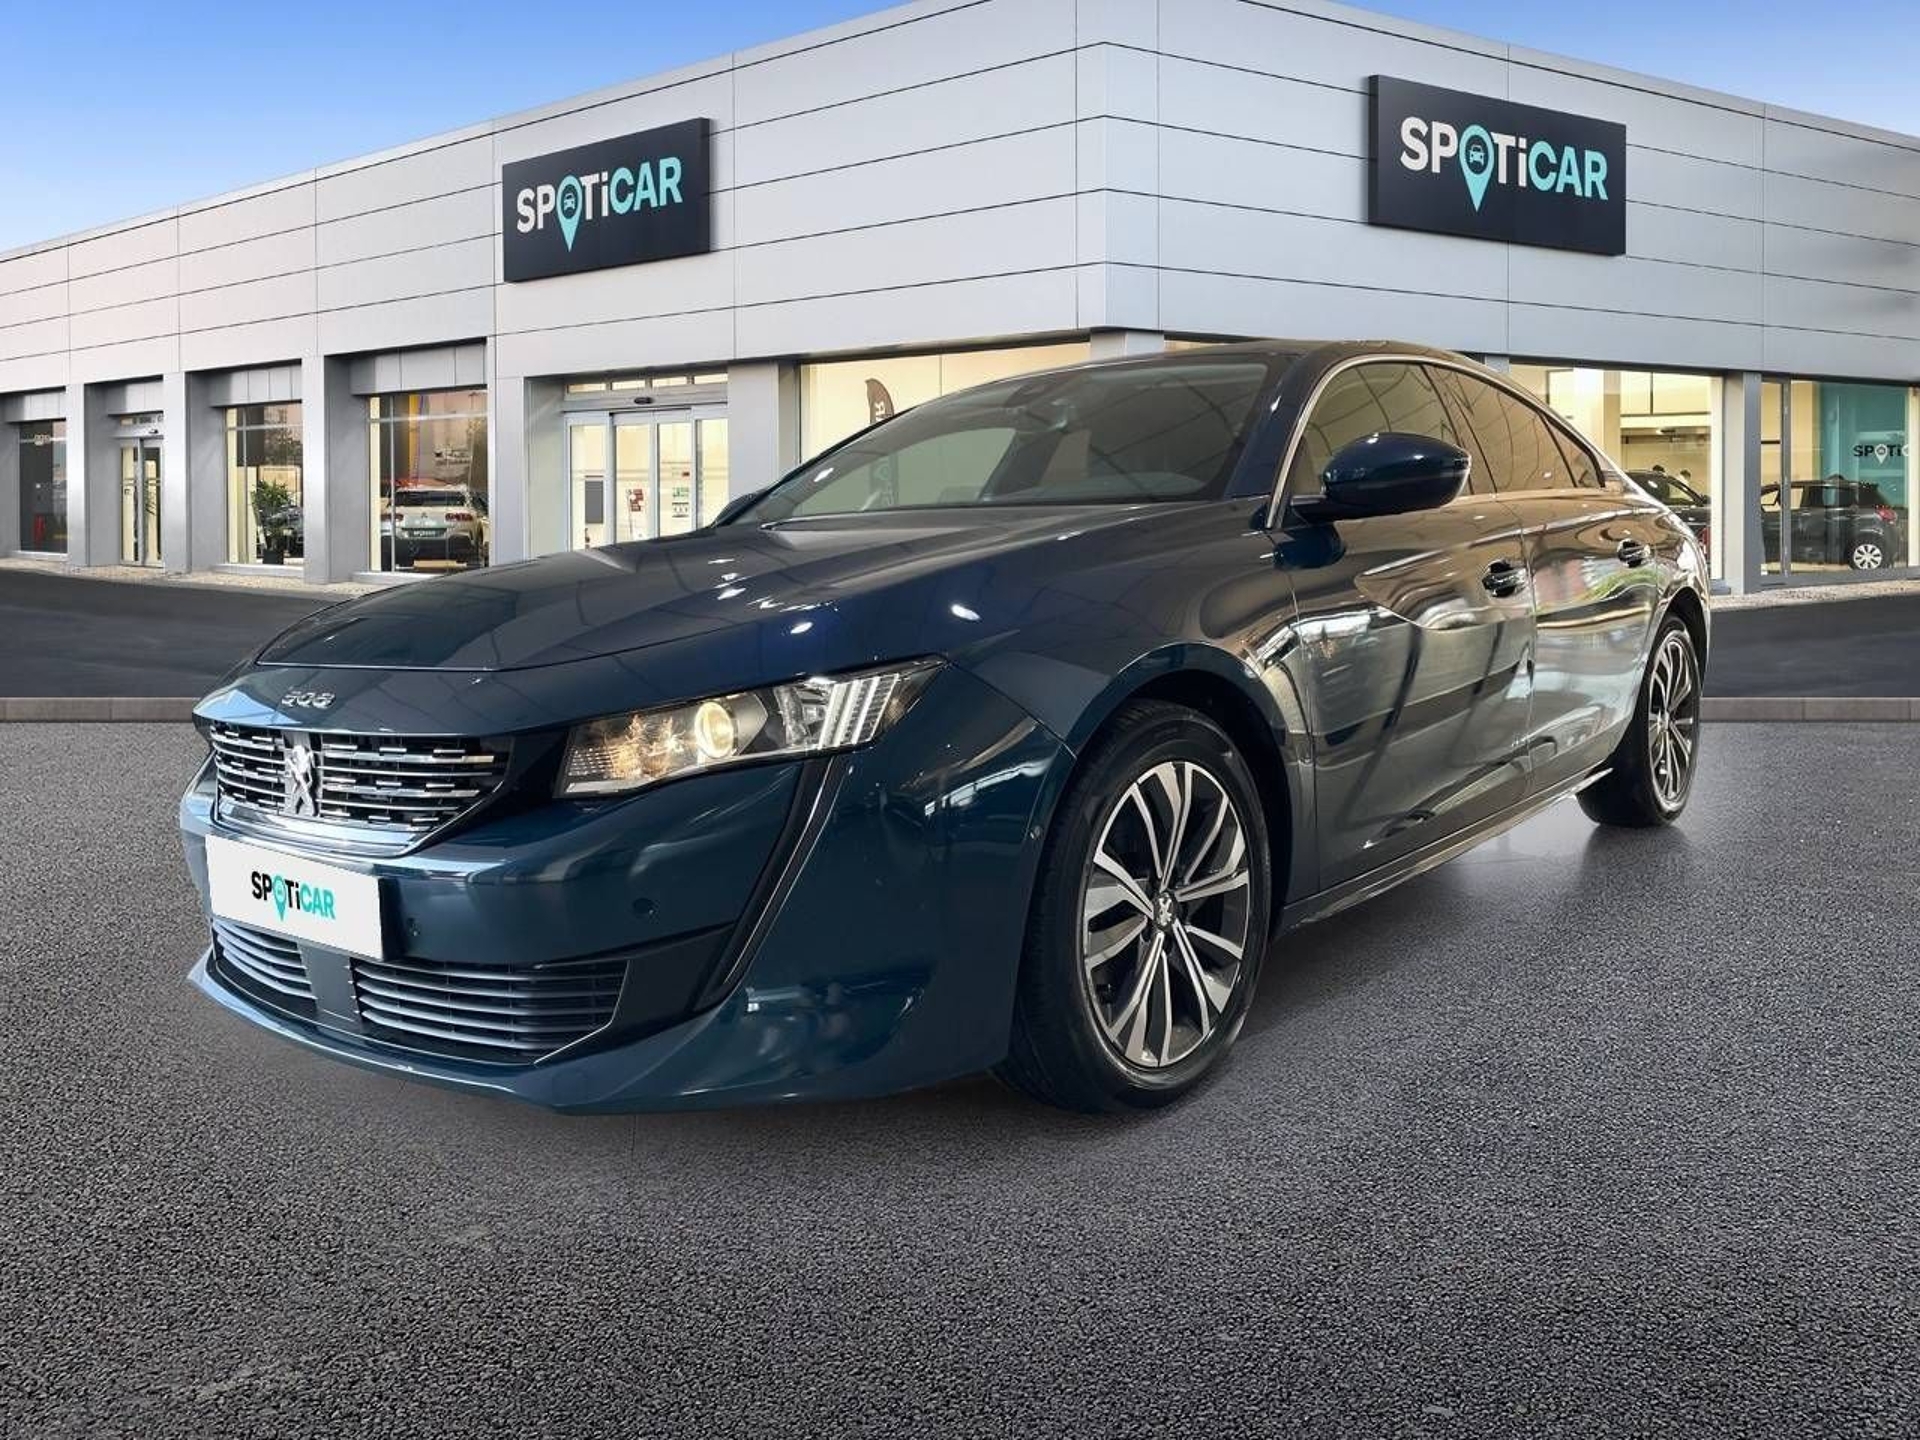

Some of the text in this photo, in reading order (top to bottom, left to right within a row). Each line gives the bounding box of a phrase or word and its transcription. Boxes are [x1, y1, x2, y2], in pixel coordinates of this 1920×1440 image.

[516, 156, 683, 253] SPOTiCAR
[1400, 116, 1609, 213] SPOTiCAR
[251, 871, 335, 921] SPOTiCAR
